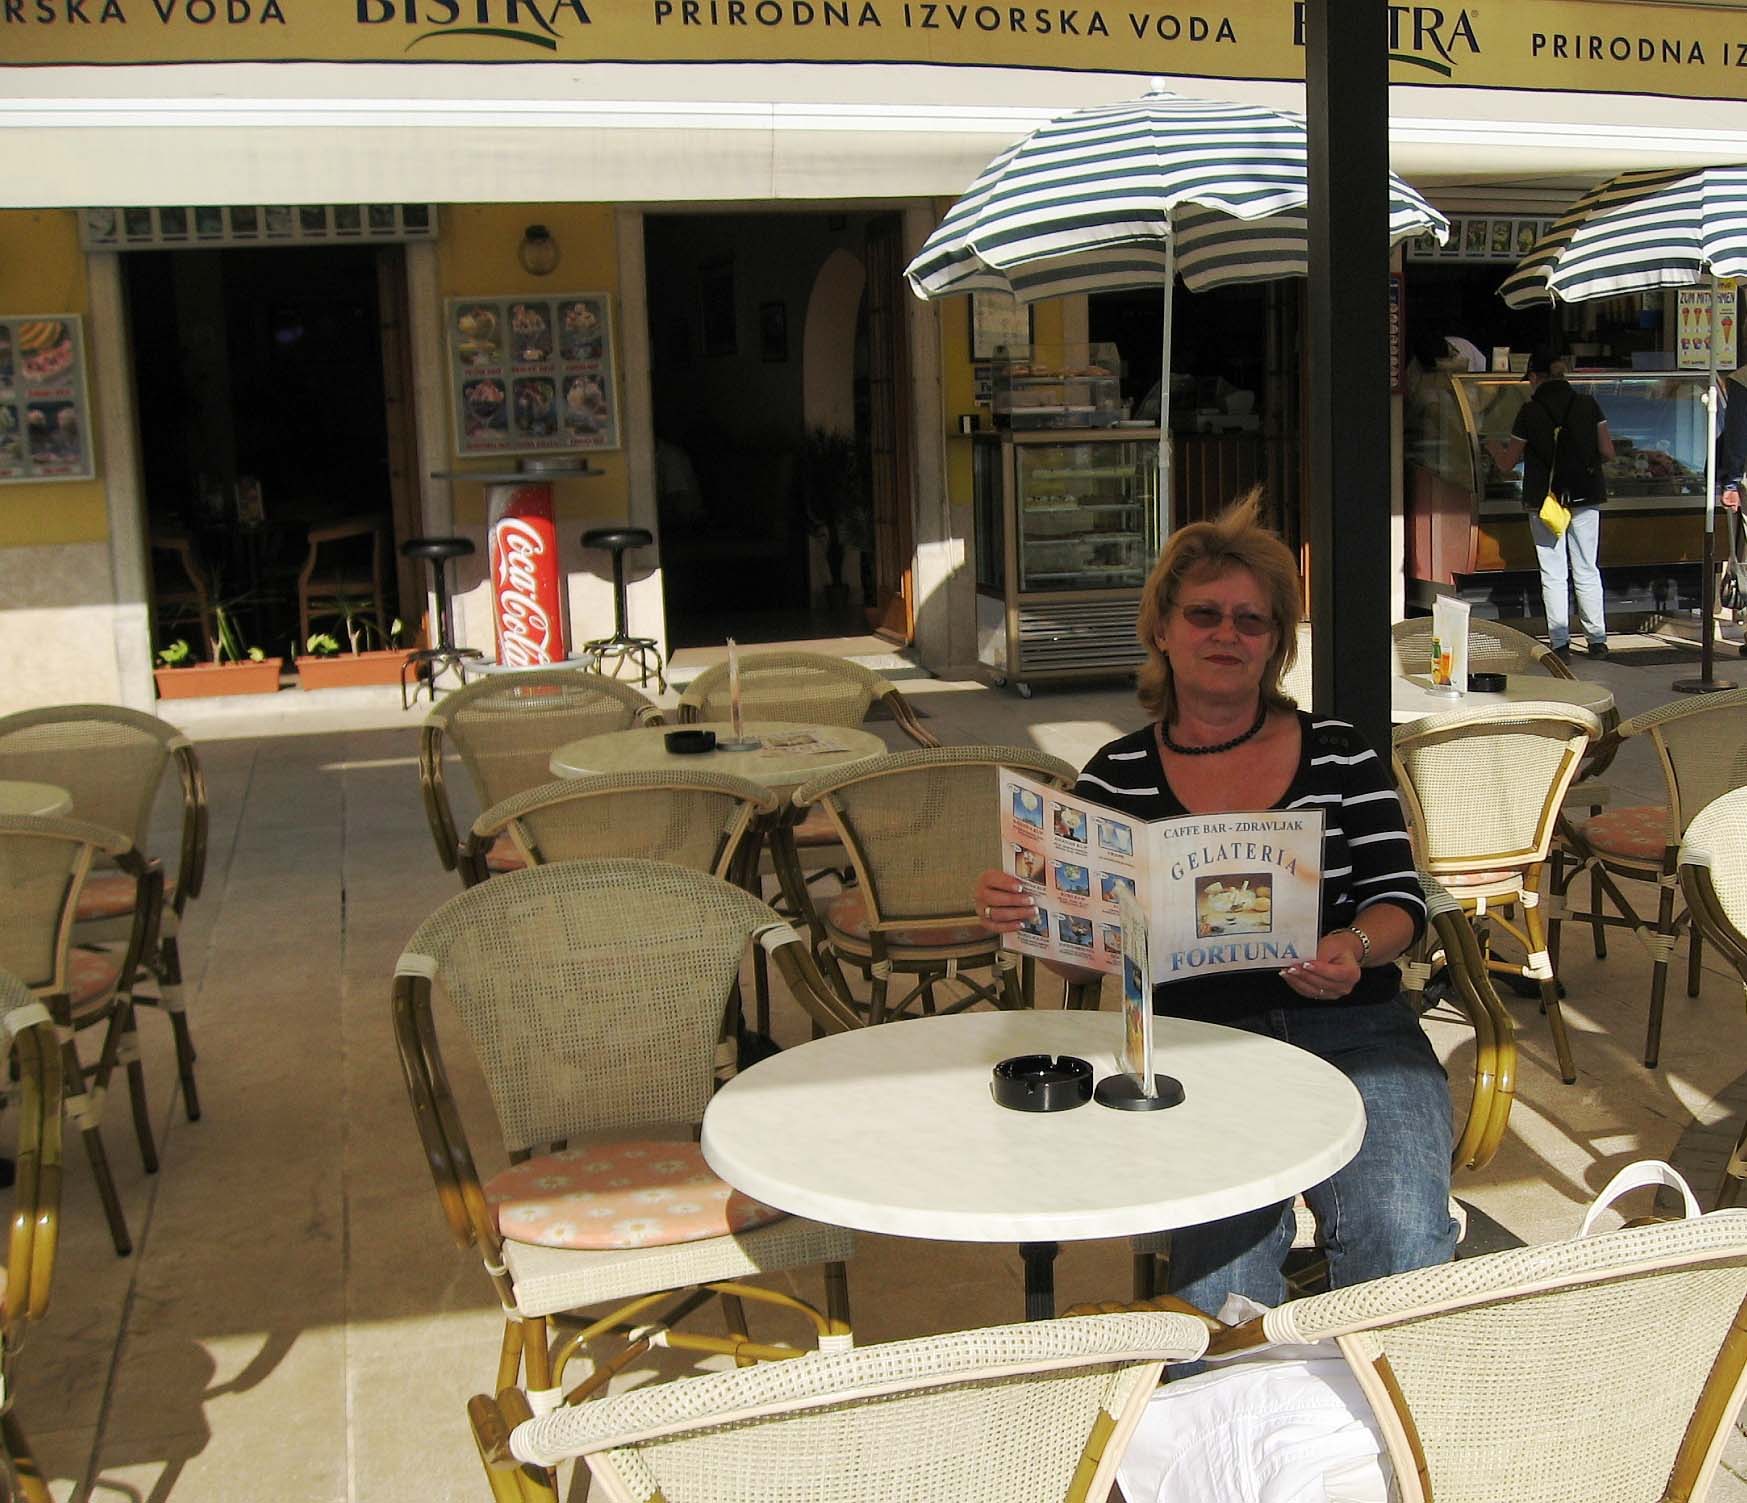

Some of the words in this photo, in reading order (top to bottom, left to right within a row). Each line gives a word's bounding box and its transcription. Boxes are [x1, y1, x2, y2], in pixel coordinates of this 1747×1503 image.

[153, 0, 287, 25] VODA
[654, 0, 882, 27] PRIRODNA
[903, 3, 1110, 37] IZVORSKA
[1128, 12, 1237, 43] VODA
[1531, 33, 1706, 65] PRIRODNA
[1722, 42, 1747, 67] IZ
[1163, 825, 1200, 840] CAFFE
[1203, 823, 1226, 834] BAR
[1235, 820, 1303, 832] ZDRAVLJAK
[1171, 842, 1298, 881] GELATERIA
[1171, 941, 1300, 971] FORTUNA
